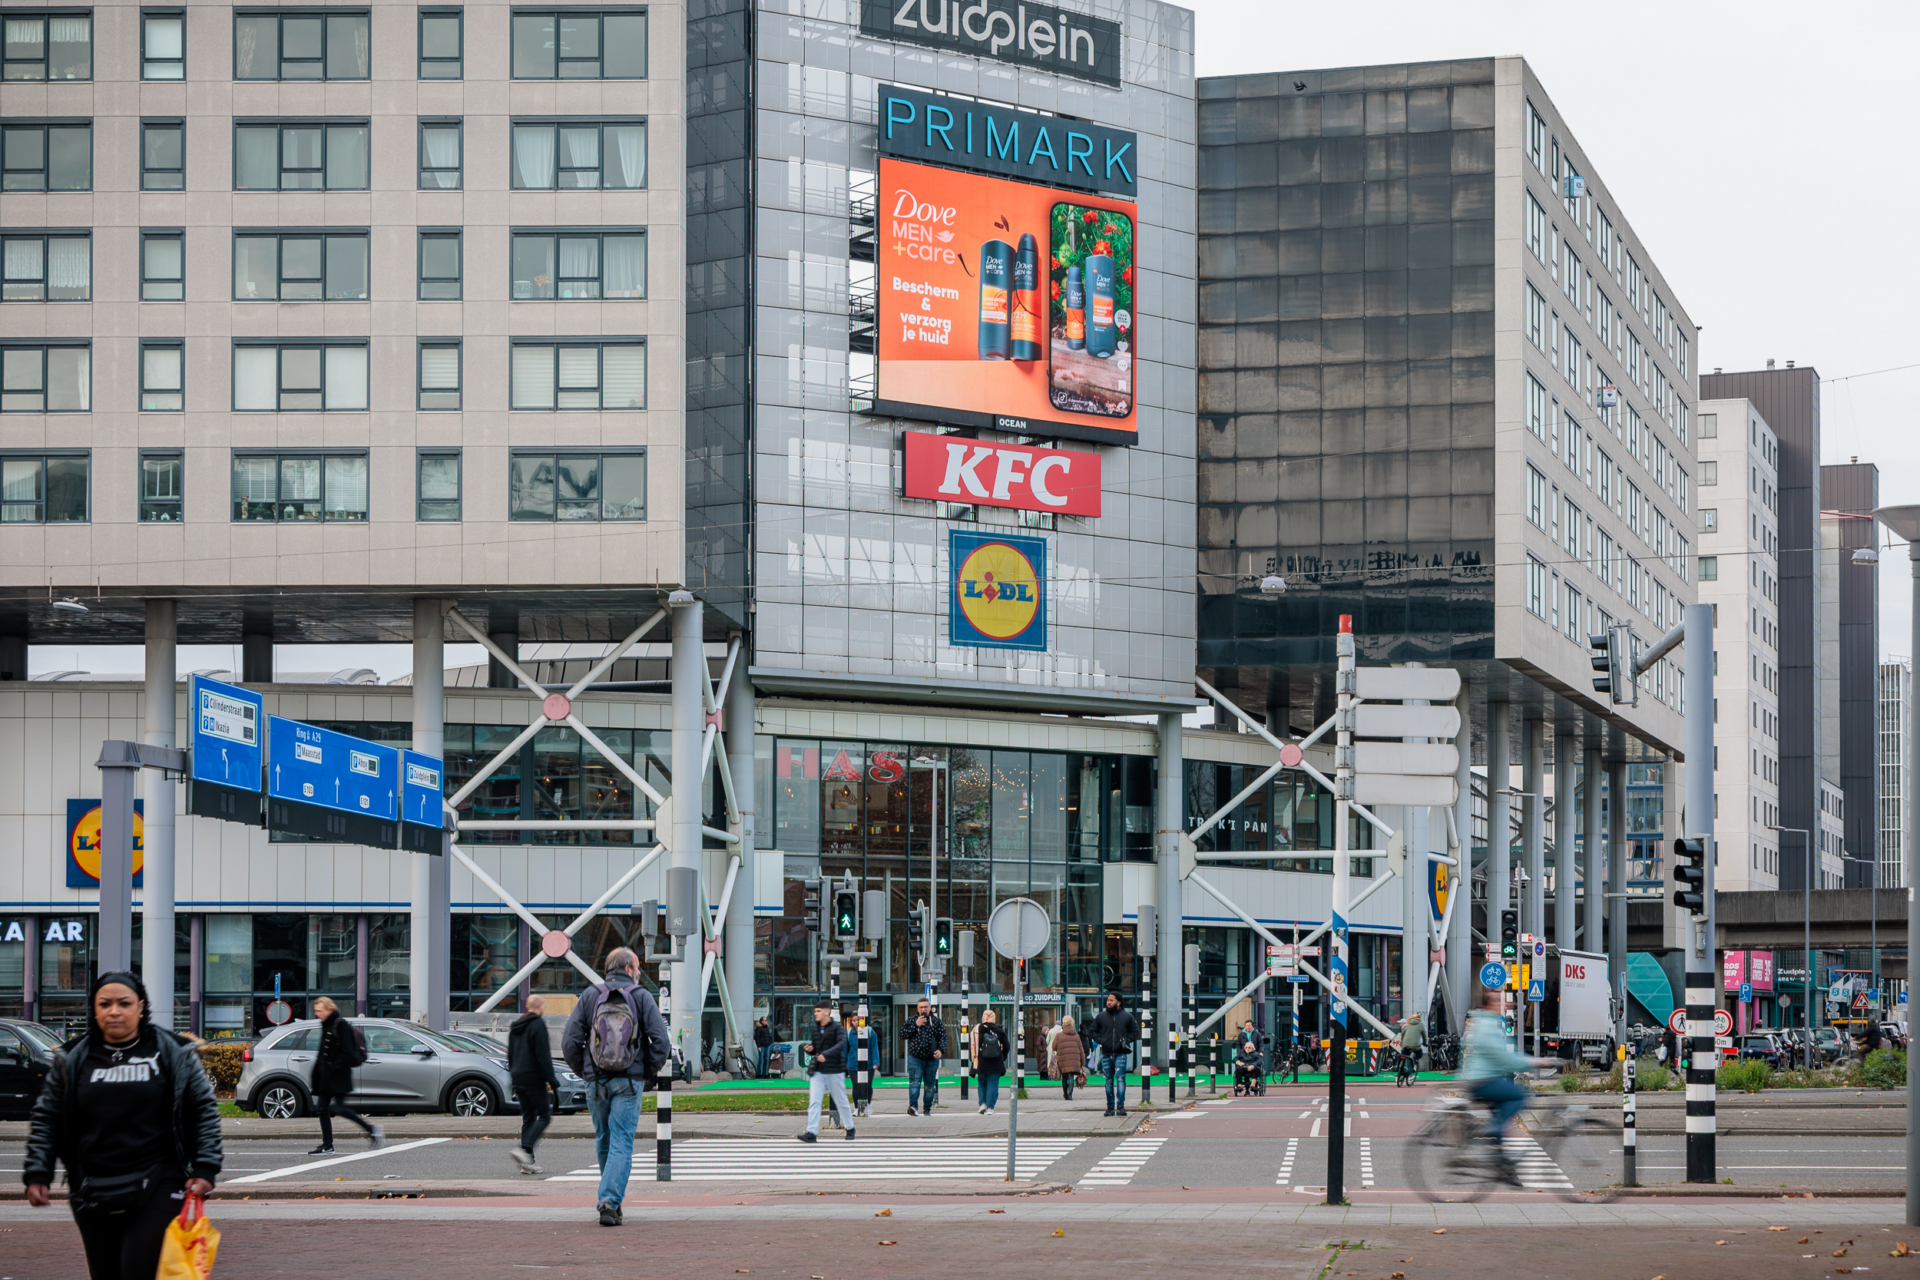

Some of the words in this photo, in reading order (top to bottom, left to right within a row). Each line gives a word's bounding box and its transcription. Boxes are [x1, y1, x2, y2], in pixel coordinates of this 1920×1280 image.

[887, 97, 1133, 183] PRIMARK
[893, 189, 957, 226] Dove
[892, 220, 933, 243] MEN
[892, 277, 959, 300] Bescherm
[921, 297, 932, 311] &
[900, 310, 952, 333] verzorg
[902, 325, 917, 343] je
[919, 328, 949, 345] huid
[999, 417, 1027, 430] OCEAN
[938, 443, 1071, 507] KFC
[964, 572, 1034, 604] LIDL
[210, 698, 242, 717] Cilinderstraat
[216, 720, 230, 734] Ikazia
[296, 727, 306, 742] Ring
[312, 731, 321, 743] A29
[302, 746, 321, 760] Maasstad
[358, 757, 367, 771] Ahoy
[777, 746, 903, 783] HAS
[414, 769, 429, 782] Zuidplein
[1244, 820, 1268, 833] PAN
[1565, 963, 1585, 980] DKS
[90, 1064, 150, 1083] PUMA
